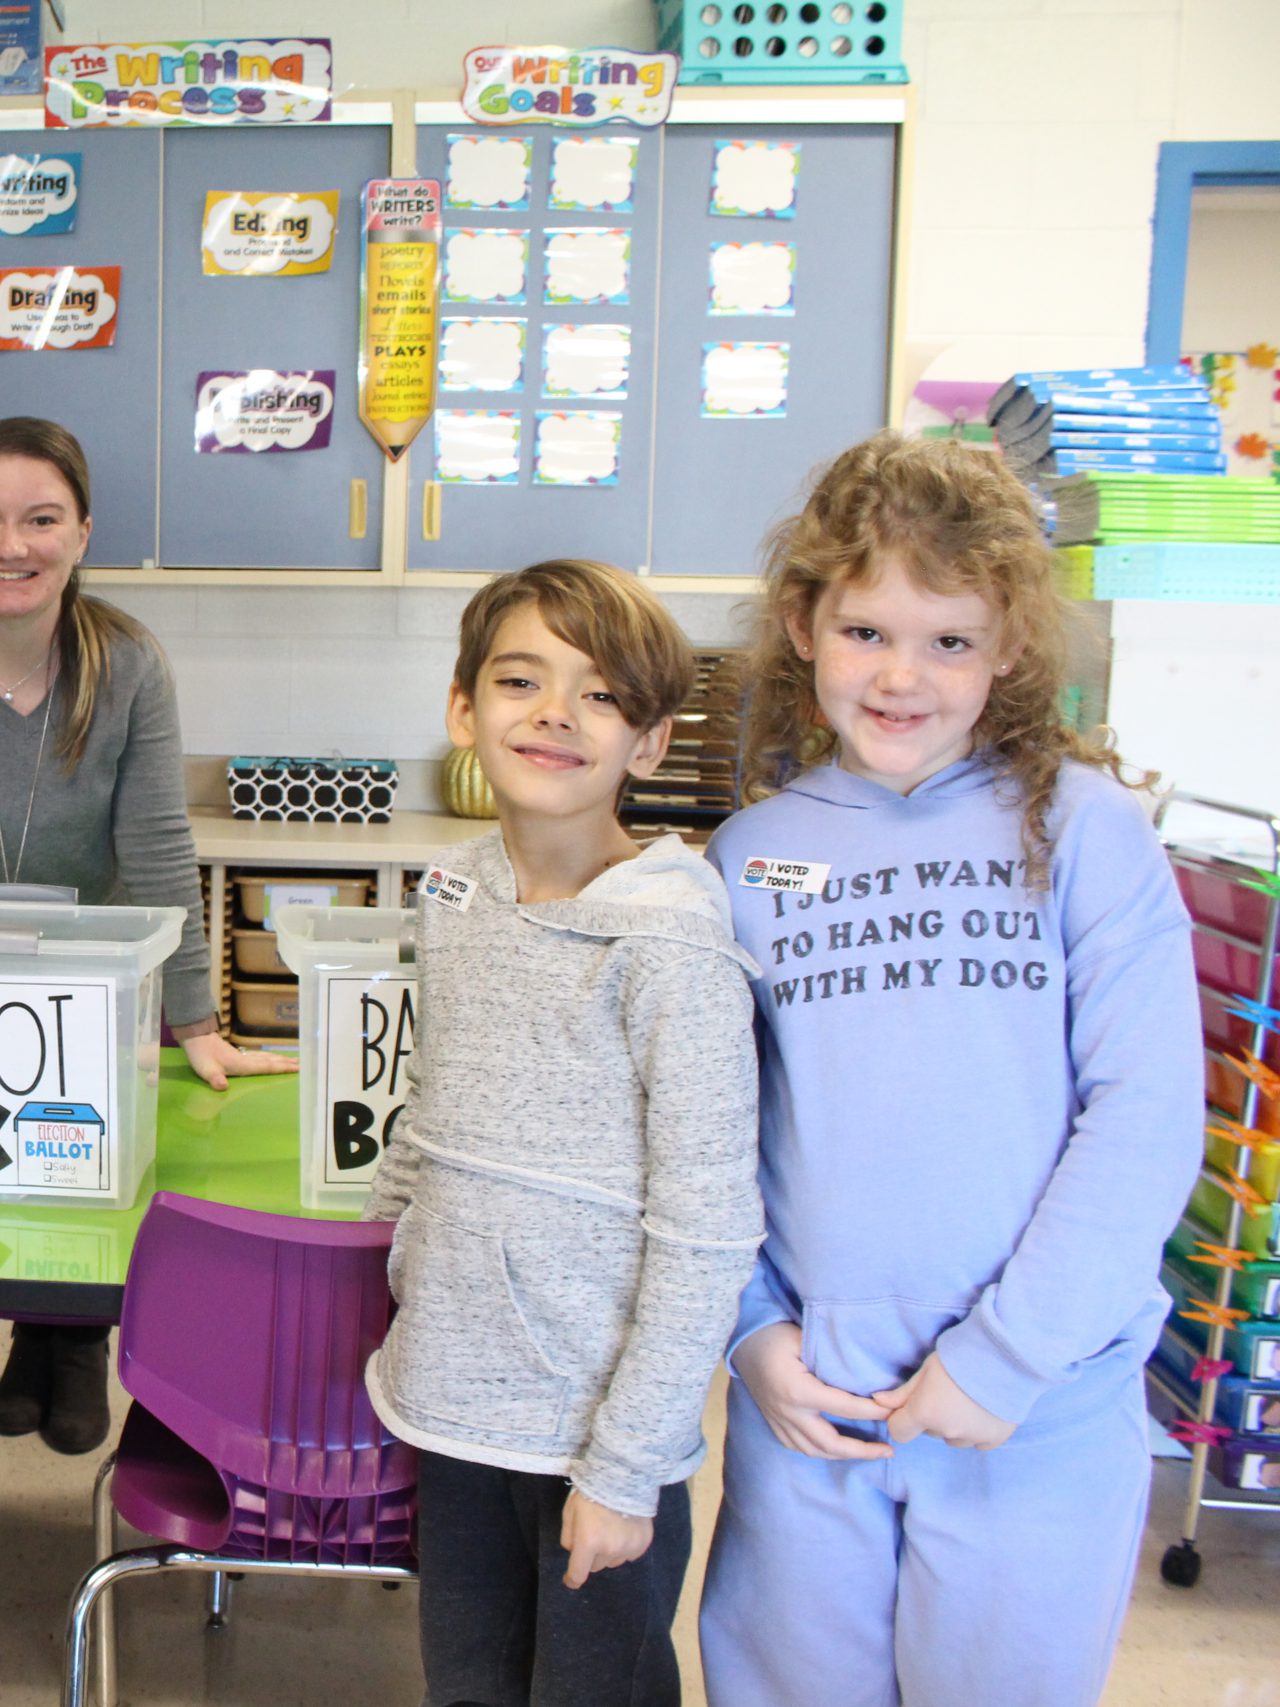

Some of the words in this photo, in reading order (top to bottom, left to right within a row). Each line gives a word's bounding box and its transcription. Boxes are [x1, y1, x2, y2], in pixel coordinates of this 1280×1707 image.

[71, 54, 107, 71] The
[115, 50, 304, 95] Writing
[513, 56, 665, 97] Writing
[72, 81, 266, 118] Process
[478, 84, 596, 117] Goals
[414, 185, 429, 196] do
[371, 200, 435, 212] WRITERS
[384, 215, 422, 225] write?
[380, 245, 424, 258] poetry
[377, 289, 426, 301] emails
[71, 313, 80, 321] to
[375, 346, 427, 357] PLAYS
[376, 376, 423, 387] articles
[270, 426, 291, 436] Copy
[747, 868, 766, 877] VOTE
[777, 864, 809, 876] VOTED
[447, 876, 469, 893] VOTED
[766, 876, 804, 891] TODAY!
[288, 897, 314, 905] Green
[438, 888, 462, 908] TODAY!
[773, 891, 786, 918] I
[771, 931, 814, 964] TO
[827, 910, 944, 952] HANG
[773, 965, 867, 1009] WITH
[882, 958, 942, 990] MY
[959, 958, 1048, 991] DOG
[37, 1124, 85, 1142] ELECTION
[25, 1141, 93, 1160] BALLOT
[52, 1162, 77, 1175] Salty
[52, 1174, 78, 1184] Sweet
